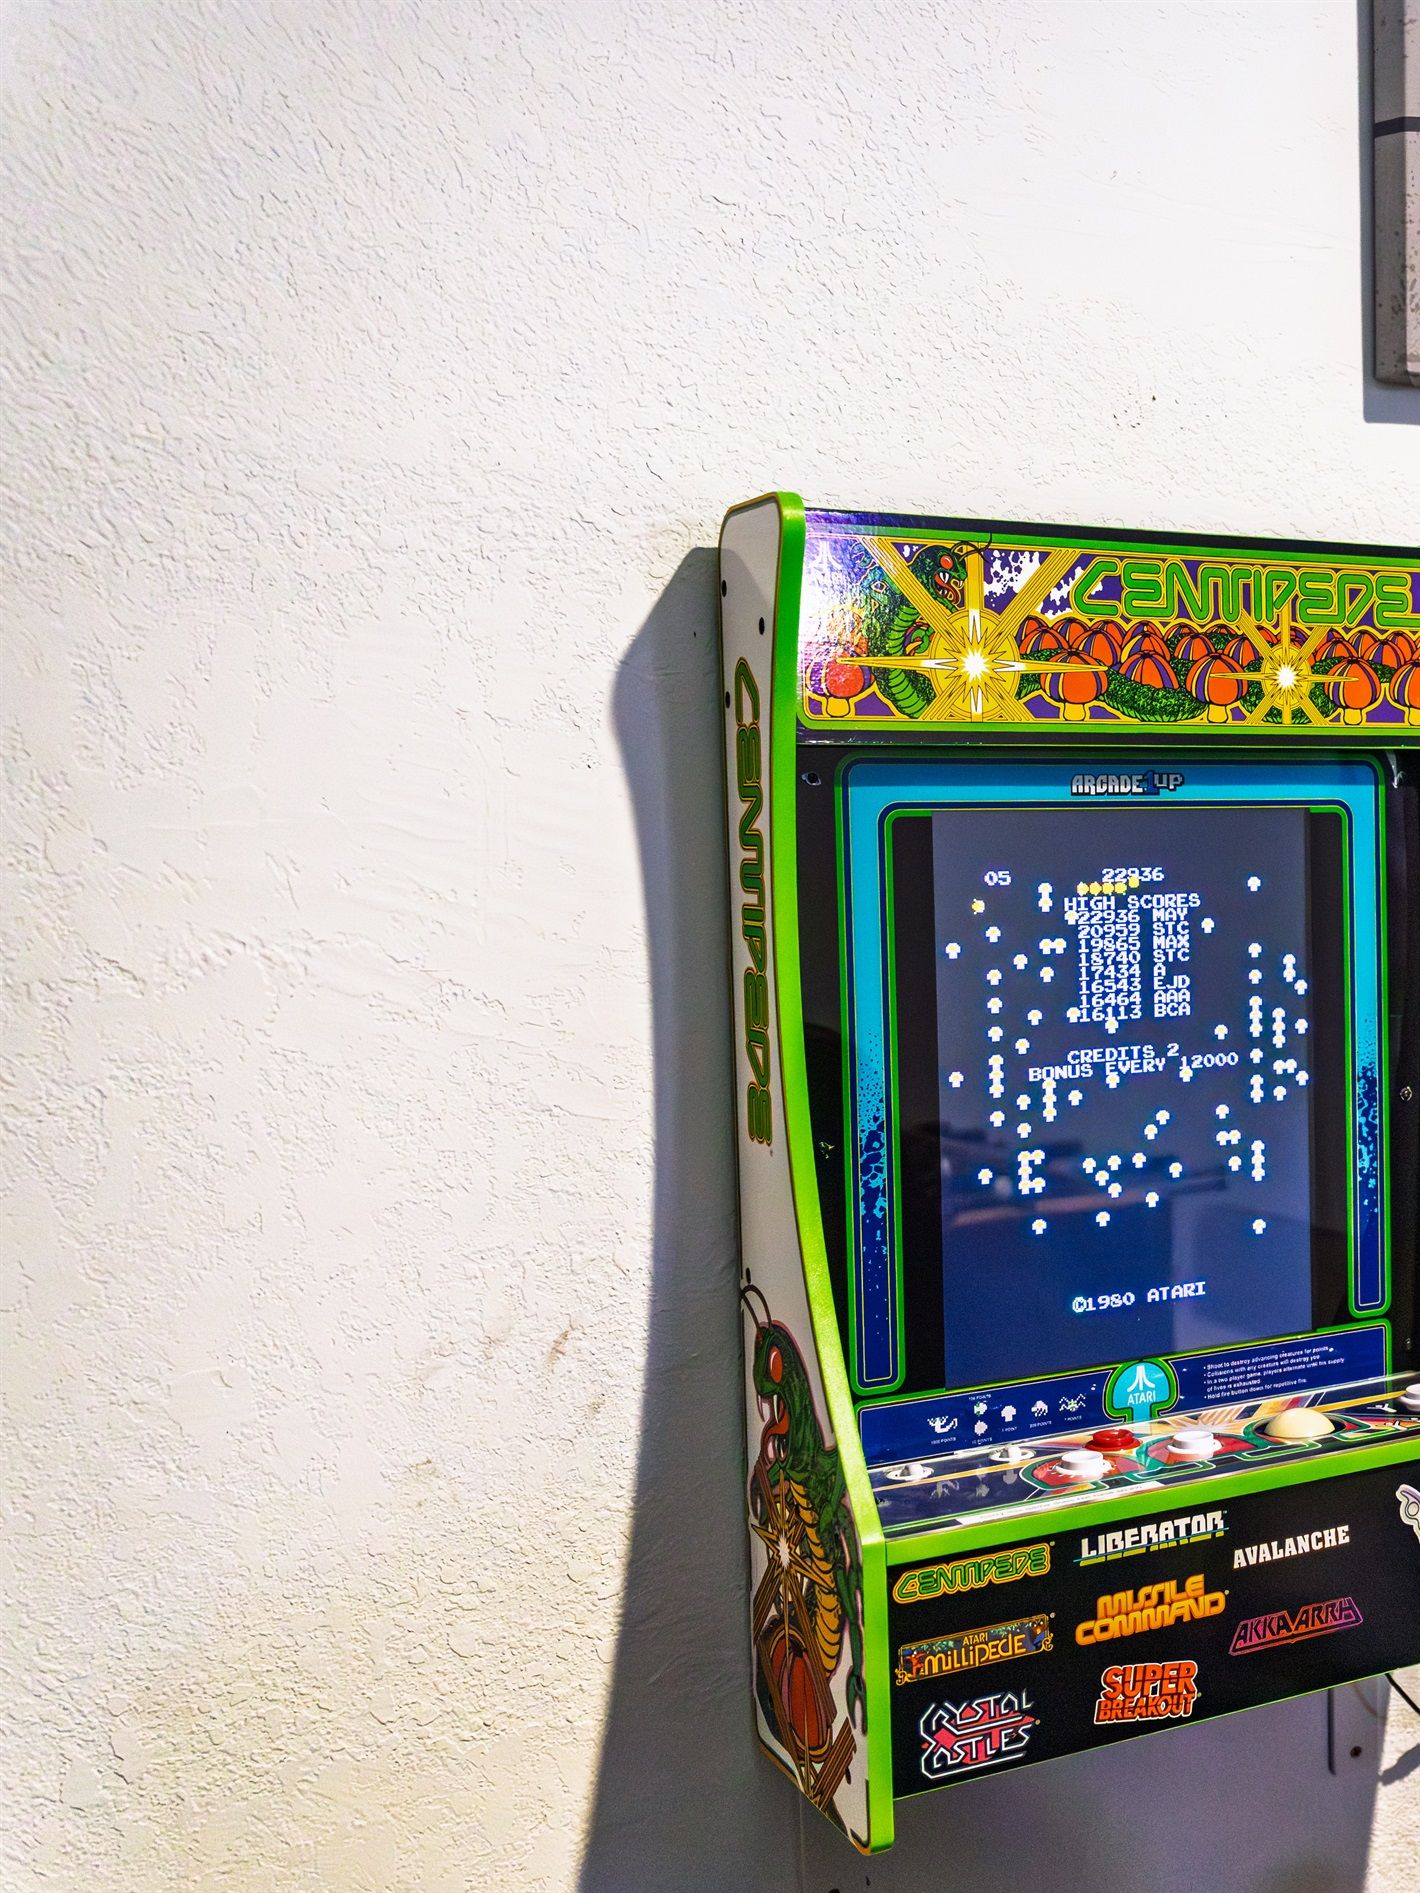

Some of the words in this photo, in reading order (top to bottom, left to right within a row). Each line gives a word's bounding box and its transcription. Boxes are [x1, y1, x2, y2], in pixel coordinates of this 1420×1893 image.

[1073, 558, 1412, 630] CENTIPEDE
[985, 870, 1012, 886] 05
[1102, 867, 1165, 884] 22936
[735, 657, 773, 1146] CENTIPEDE
[1064, 896, 1116, 912] HIGH
[1127, 893, 1201, 909] SCORES
[1078, 910, 1140, 925] 22936
[1152, 908, 1188, 922] MAY
[1078, 923, 1141, 939] 20959
[1152, 921, 1190, 936] STC
[1078, 938, 1141, 953] 19865
[1152, 935, 1190, 949] MAX
[1078, 951, 1141, 967] 18740
[1152, 948, 1190, 963] STC
[1078, 964, 1141, 981] 17434
[1153, 962, 1167, 976] A
[1079, 978, 1142, 994] 16543
[1153, 975, 1191, 989] EJD
[1079, 992, 1142, 1008] 16464
[1153, 989, 1191, 1003] AAA
[1080, 1006, 1142, 1022] 16113
[1153, 1003, 1192, 1018] BCA
[1067, 1044, 1156, 1065] CREDITS
[1166, 1042, 1180, 1057] 2
[1028, 1064, 1094, 1082] BONUS
[1105, 1057, 1166, 1076] EVERY
[1179, 1051, 1240, 1070] 12000
[1072, 1291, 1136, 1314] ©1980
[1146, 1281, 1206, 1303] ATARI
[1127, 1390, 1156, 1406] ATARI
[1080, 1509, 1225, 1560] LIBERATOR
[1233, 1525, 1350, 1569] AVALANCHE
[894, 1545, 1050, 1602] CENTIPEDE
[1097, 1573, 1205, 1620] MISSILE
[1075, 1591, 1226, 1646] COMMAND
[963, 1632, 988, 1646] ATARI
[1101, 1661, 1198, 1699] SUPER
[1095, 1690, 1195, 1724] BREAKOUT
